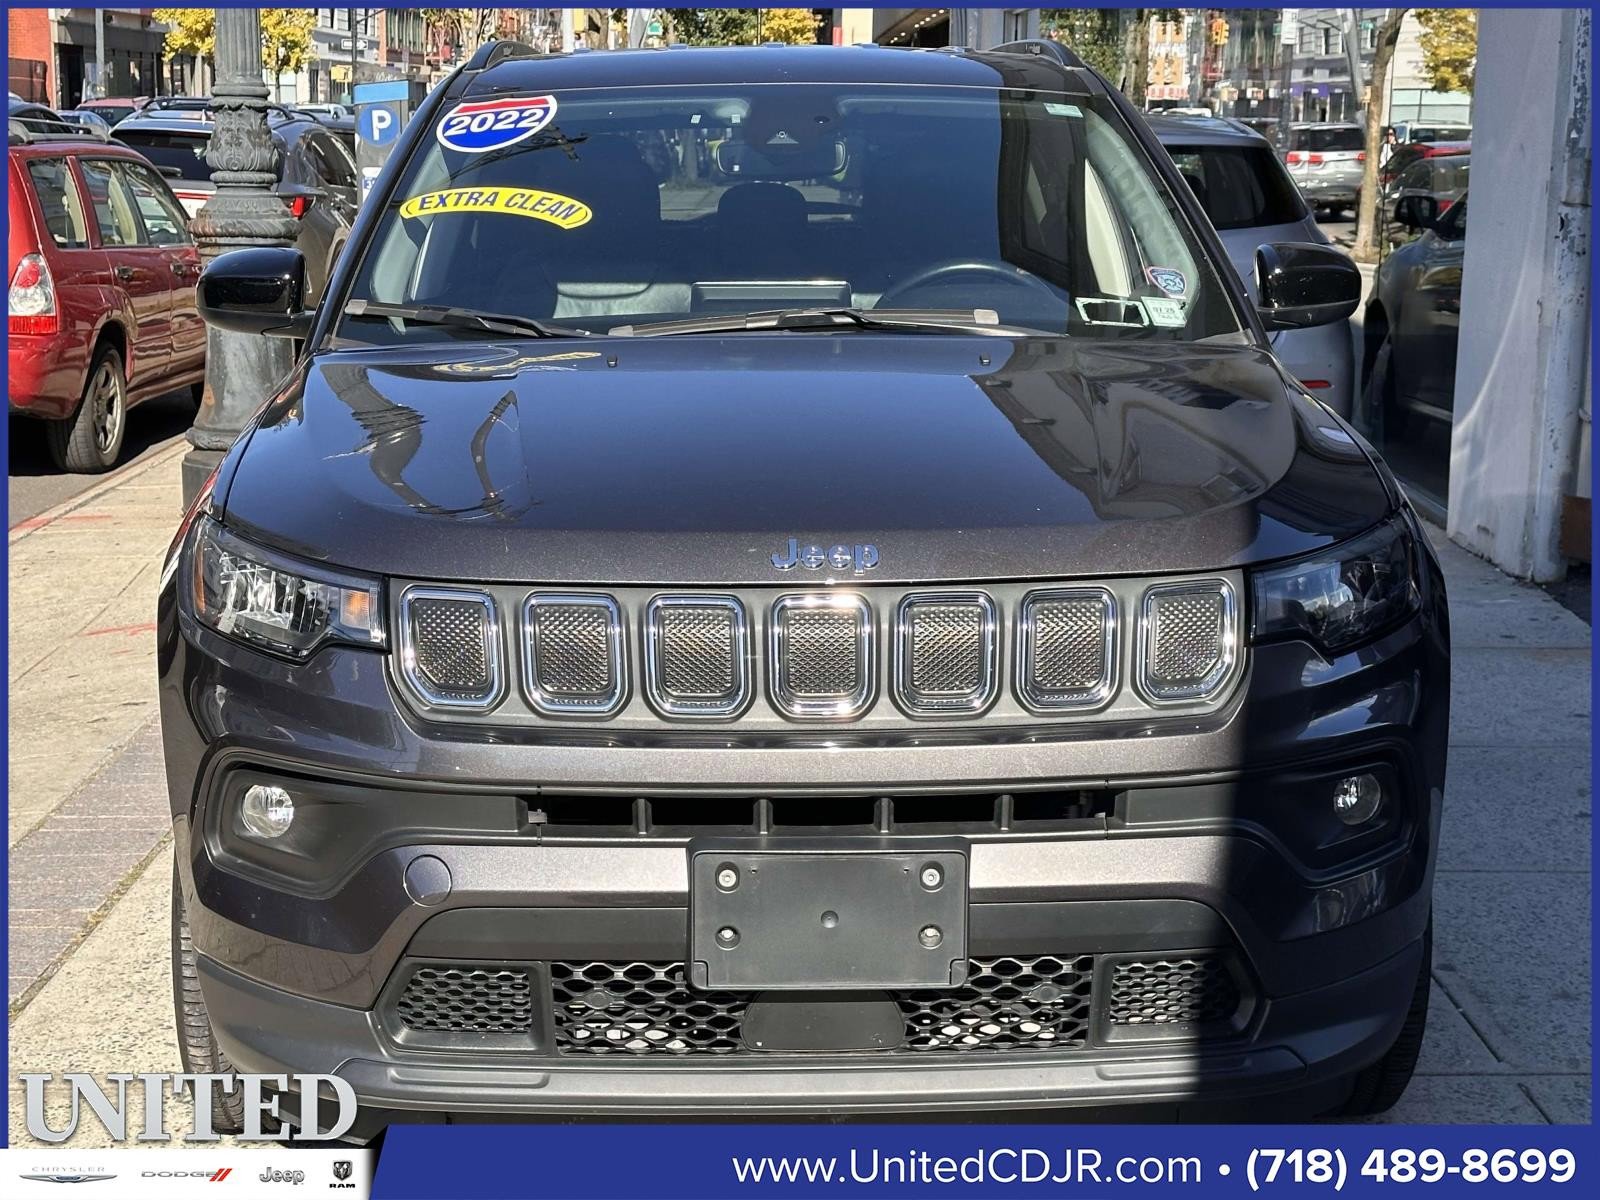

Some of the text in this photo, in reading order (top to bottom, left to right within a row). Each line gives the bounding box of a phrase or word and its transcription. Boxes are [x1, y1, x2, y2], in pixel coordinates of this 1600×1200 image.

[371, 109, 392, 141] P
[444, 108, 545, 137] 2022
[418, 191, 584, 221] EXTRA CLEAN
[770, 536, 880, 576] Jeep
